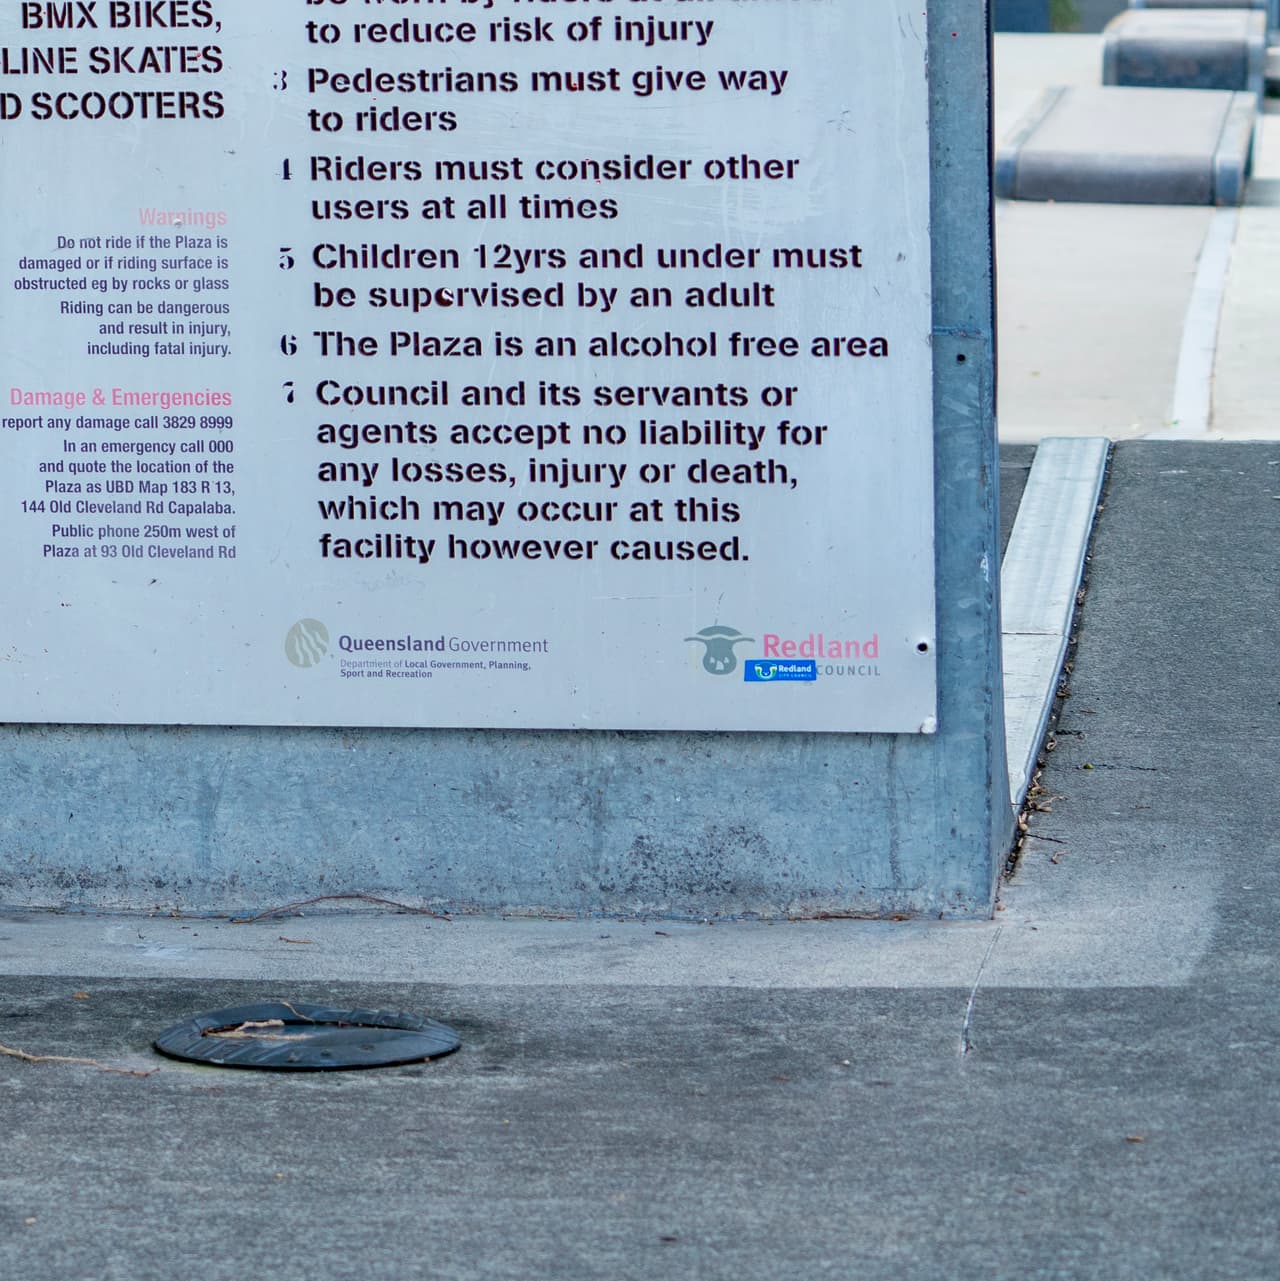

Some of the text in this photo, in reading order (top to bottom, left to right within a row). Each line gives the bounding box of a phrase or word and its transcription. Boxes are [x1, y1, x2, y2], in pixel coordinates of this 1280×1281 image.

[22, 0, 221, 33] BMX BIKES,
[305, 16, 714, 47] to reduce risk of injury
[90, 46, 222, 74] SKATES
[308, 67, 518, 93] Pedestrians
[531, 68, 620, 92] must
[633, 66, 706, 97] give
[718, 70, 788, 96] way
[31, 91, 224, 120] SCOOTERS
[311, 156, 421, 181] Riders
[436, 158, 523, 180] must
[536, 155, 692, 180] consider
[704, 154, 799, 179] other
[139, 208, 227, 230] Warnings
[58, 235, 227, 249] Do not ride if the Plaza is
[19, 256, 228, 272] damaged or if riding surface is
[280, 243, 862, 273] 5 Children 12yrs and under must
[61, 301, 229, 316] Riding can be dangerous
[99, 321, 230, 337] and result in injury,
[88, 342, 231, 357] including fatal injury.
[280, 331, 888, 357] 6 The Plaza is an alcohol free area
[11, 388, 232, 409] Damage & Emergencies
[316, 380, 448, 405] Council
[462, 381, 525, 406] and
[539, 381, 580, 406] its
[594, 384, 748, 406] servants
[761, 387, 797, 407] or
[3, 416, 43, 431] report
[48, 418, 71, 431] any
[76, 416, 130, 431] damage
[135, 416, 158, 428] call
[163, 416, 195, 428] 3829
[200, 416, 233, 429] 8999
[317, 420, 828, 450] agents accept no liability for
[46, 480, 235, 496] Plaza as UBD Map 183 R 13,
[22, 500, 235, 516] 144 Old Cleveland Rd Capalaba.
[52, 524, 236, 540] Public phone 250m west of
[43, 545, 236, 558] Plaza at 93 Old Cleveland Rd
[319, 533, 748, 564] facility however caused.
[339, 635, 548, 652] Queensland Government
[763, 632, 879, 658] Redland
[340, 669, 433, 679] Sport and Recreation
[816, 665, 880, 676] COUNCIL
